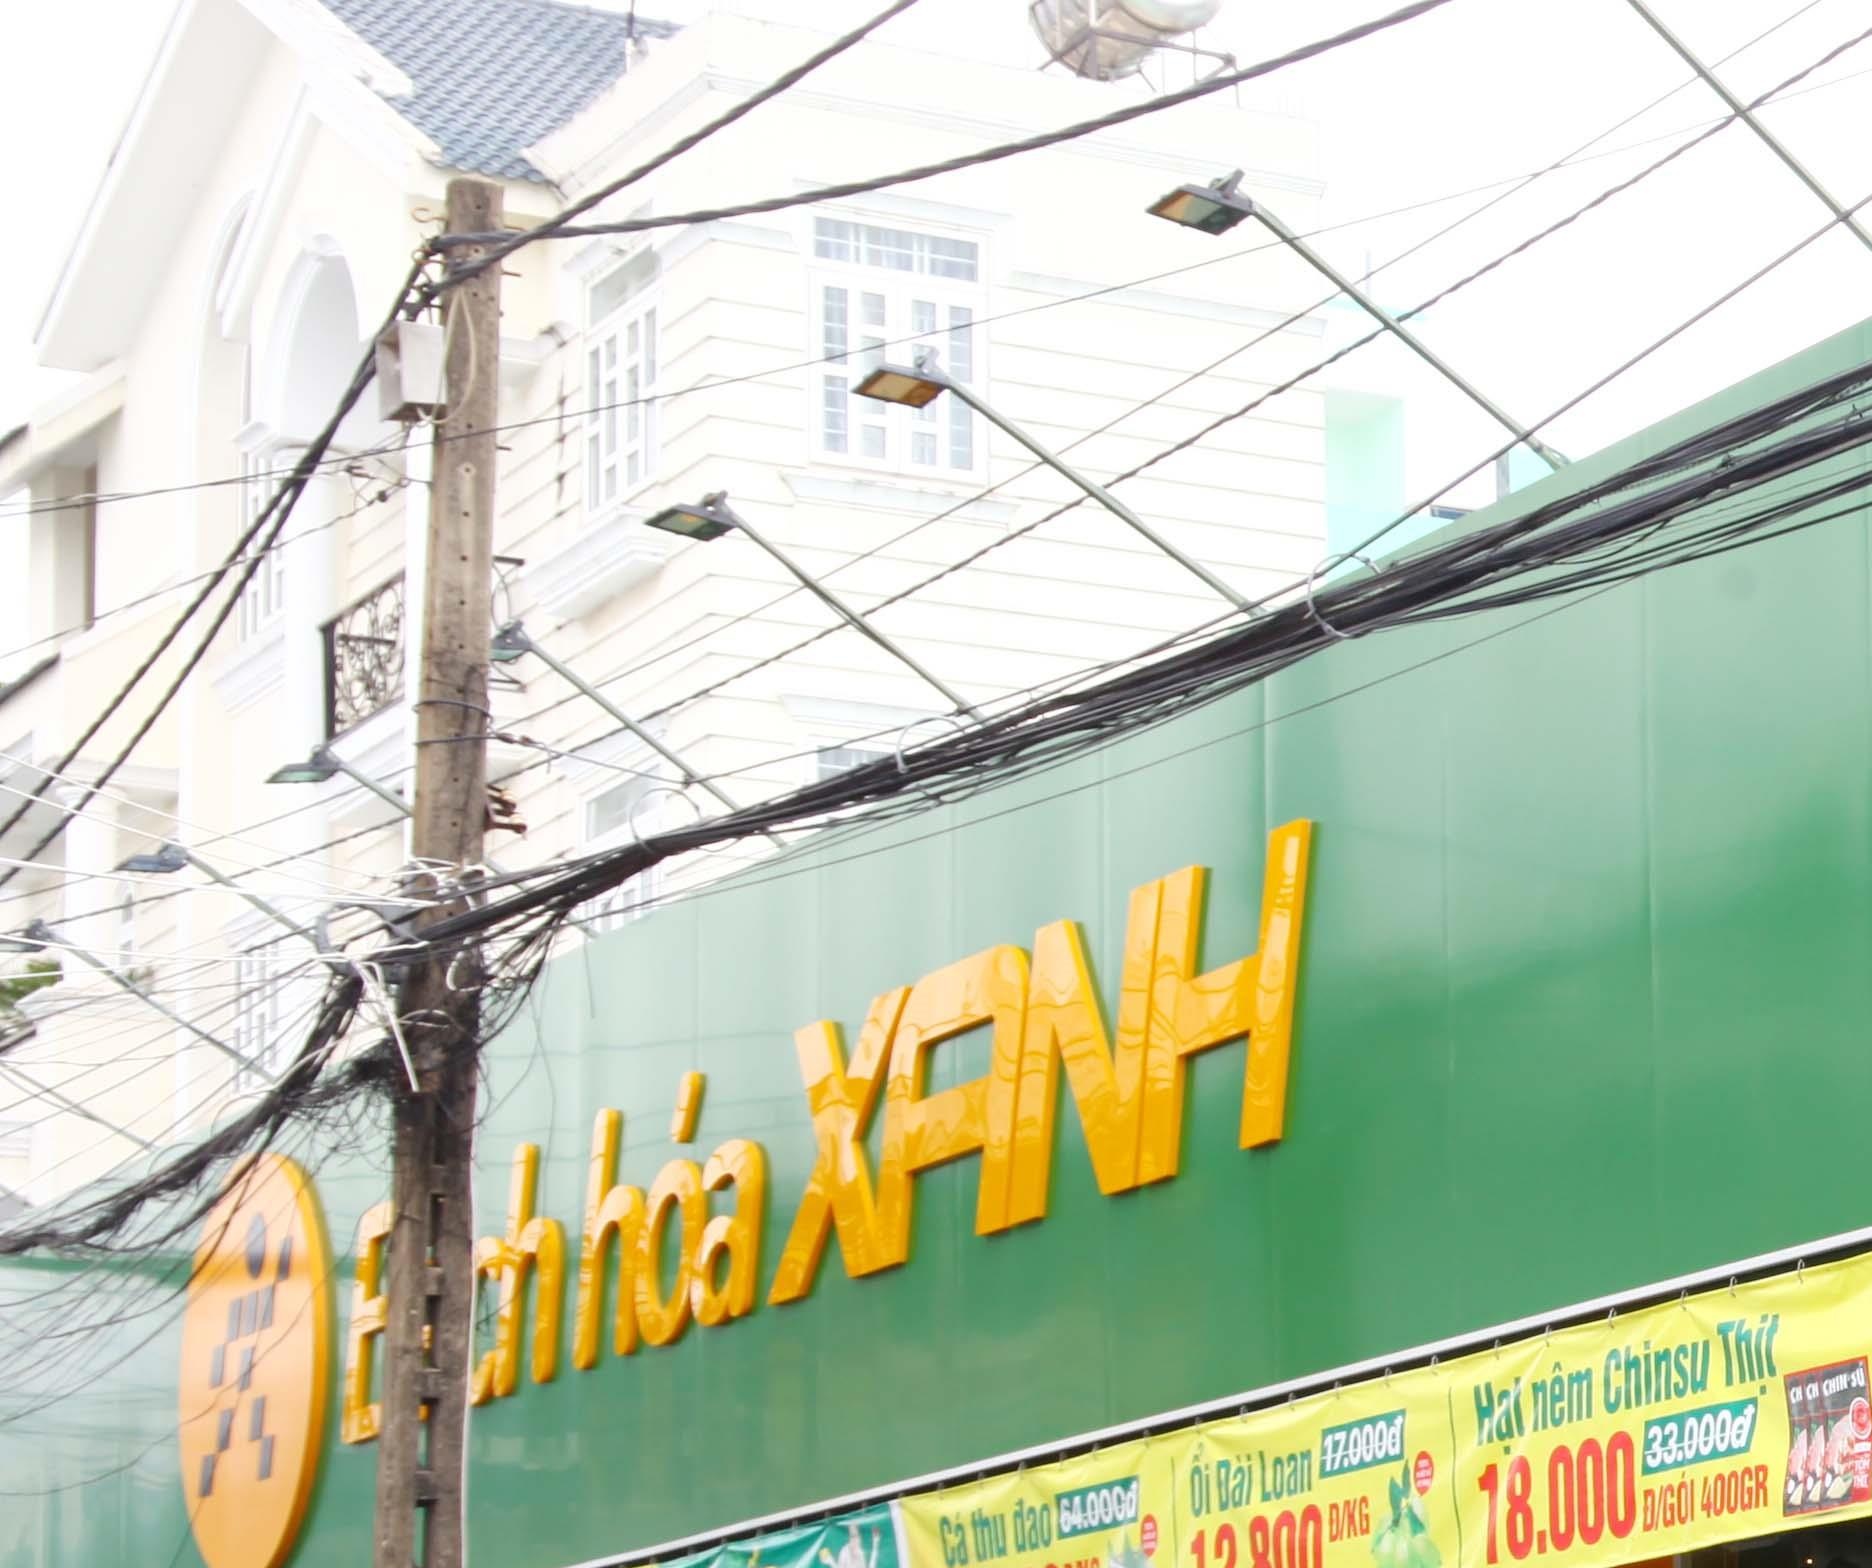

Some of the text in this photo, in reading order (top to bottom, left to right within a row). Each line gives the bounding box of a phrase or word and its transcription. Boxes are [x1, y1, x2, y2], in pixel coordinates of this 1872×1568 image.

[574, 1072, 766, 1371] hóa
[770, 817, 1313, 1306] XANH
[1473, 1313, 1781, 1456] Hạt nêm Chinsu Thịt
[1320, 1415, 1405, 1475] 17.000đ
[1643, 1403, 1756, 1469] 33.000đ
[1058, 1478, 1140, 1536] 64.000đ
[1189, 1438, 1314, 1519] Ổi Đài Loan
[1476, 1429, 1638, 1566] 18.000
[1642, 1462, 1770, 1533] Đ/GÓI 400GR
[939, 1495, 1052, 1568] Cá thu đao
[1328, 1494, 1371, 1544] Đ/KG
